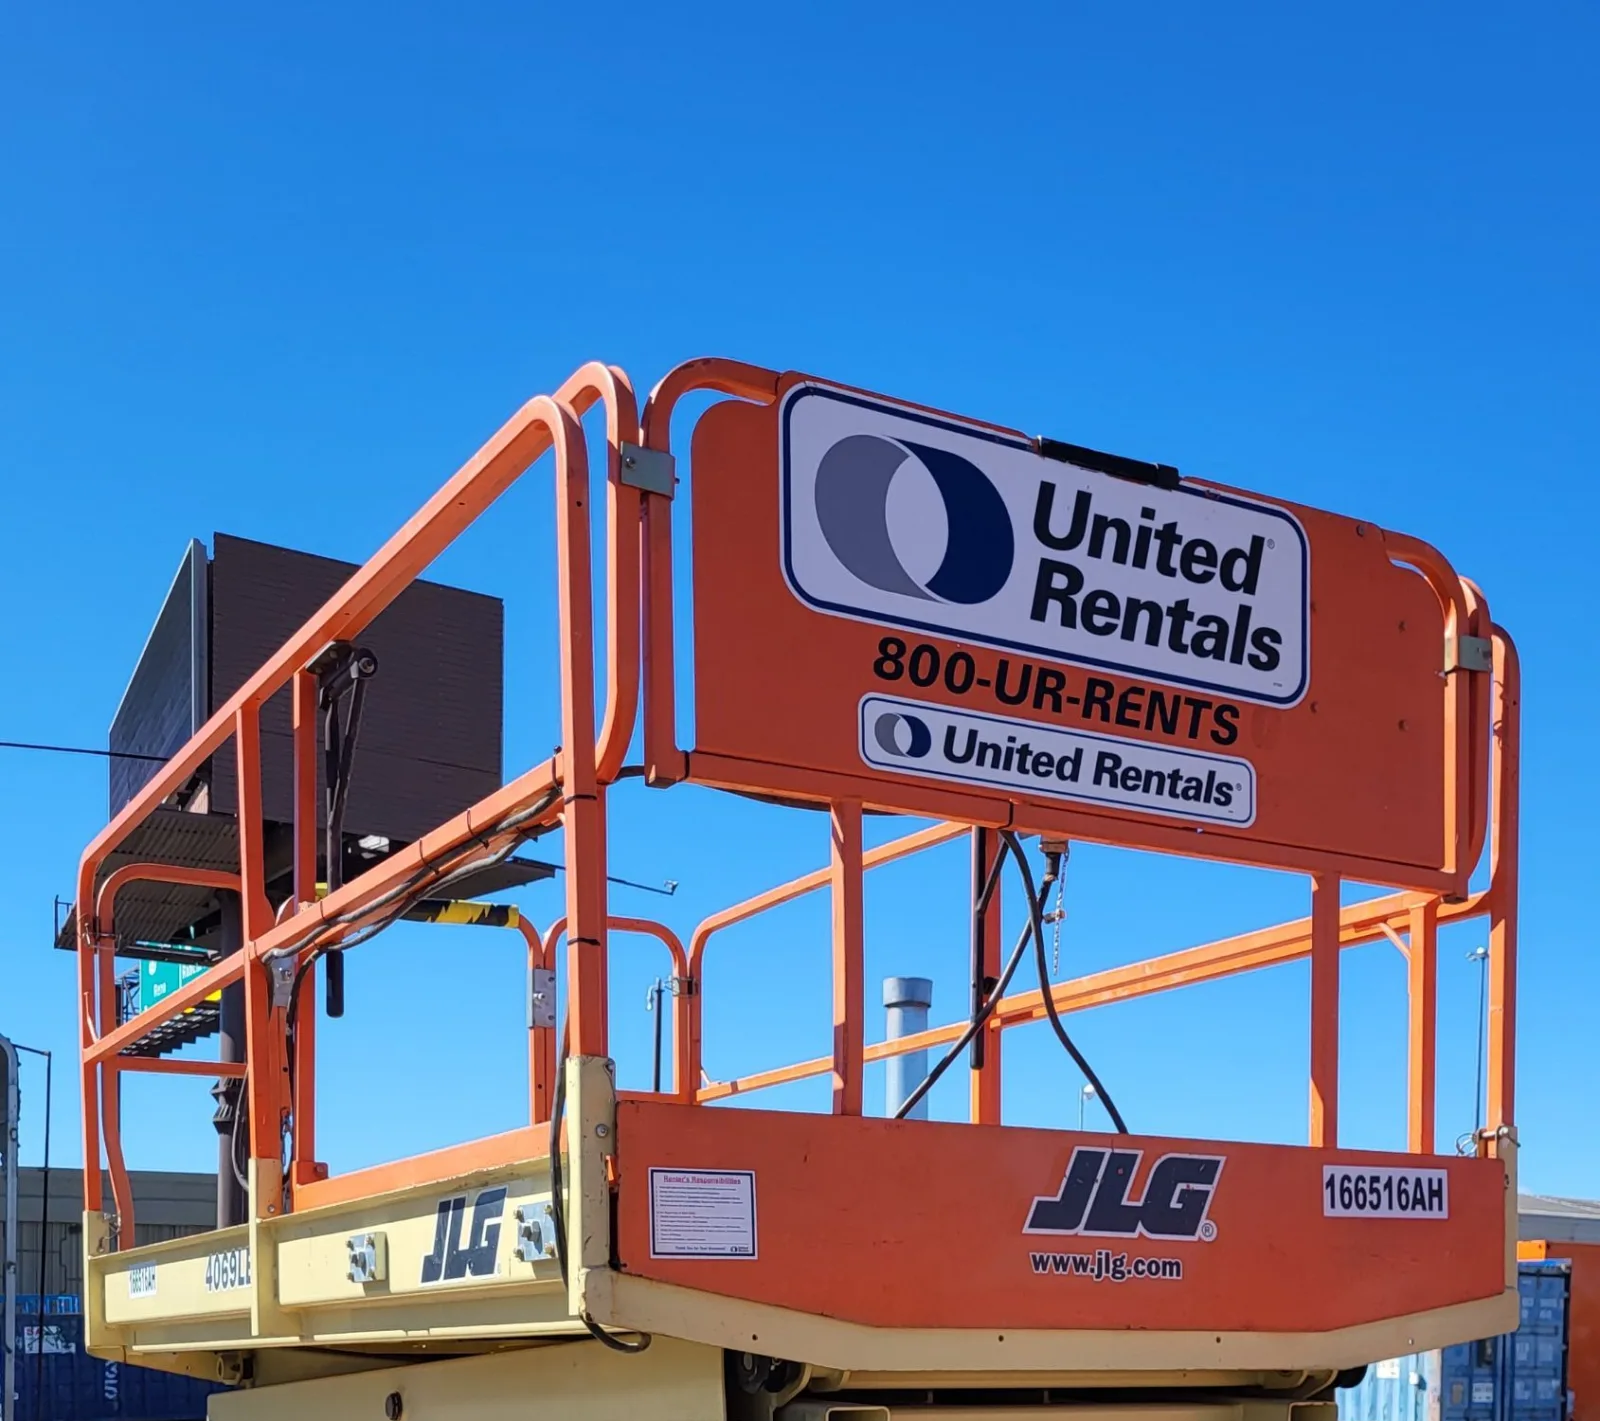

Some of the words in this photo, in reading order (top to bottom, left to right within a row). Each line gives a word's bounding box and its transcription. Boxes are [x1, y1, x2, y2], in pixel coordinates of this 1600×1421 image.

[1032, 479, 1265, 597] United
[1029, 557, 1283, 673] Rentals
[872, 636, 1241, 747] 800-UR-RENTS
[942, 724, 1084, 783] United
[1091, 750, 1234, 808] Rentals
[420, 1187, 509, 1285] JLG
[1022, 1145, 1227, 1241] JLG
[1325, 1172, 1444, 1213] 166516AH
[1030, 1251, 1182, 1281] www.jlg.com
